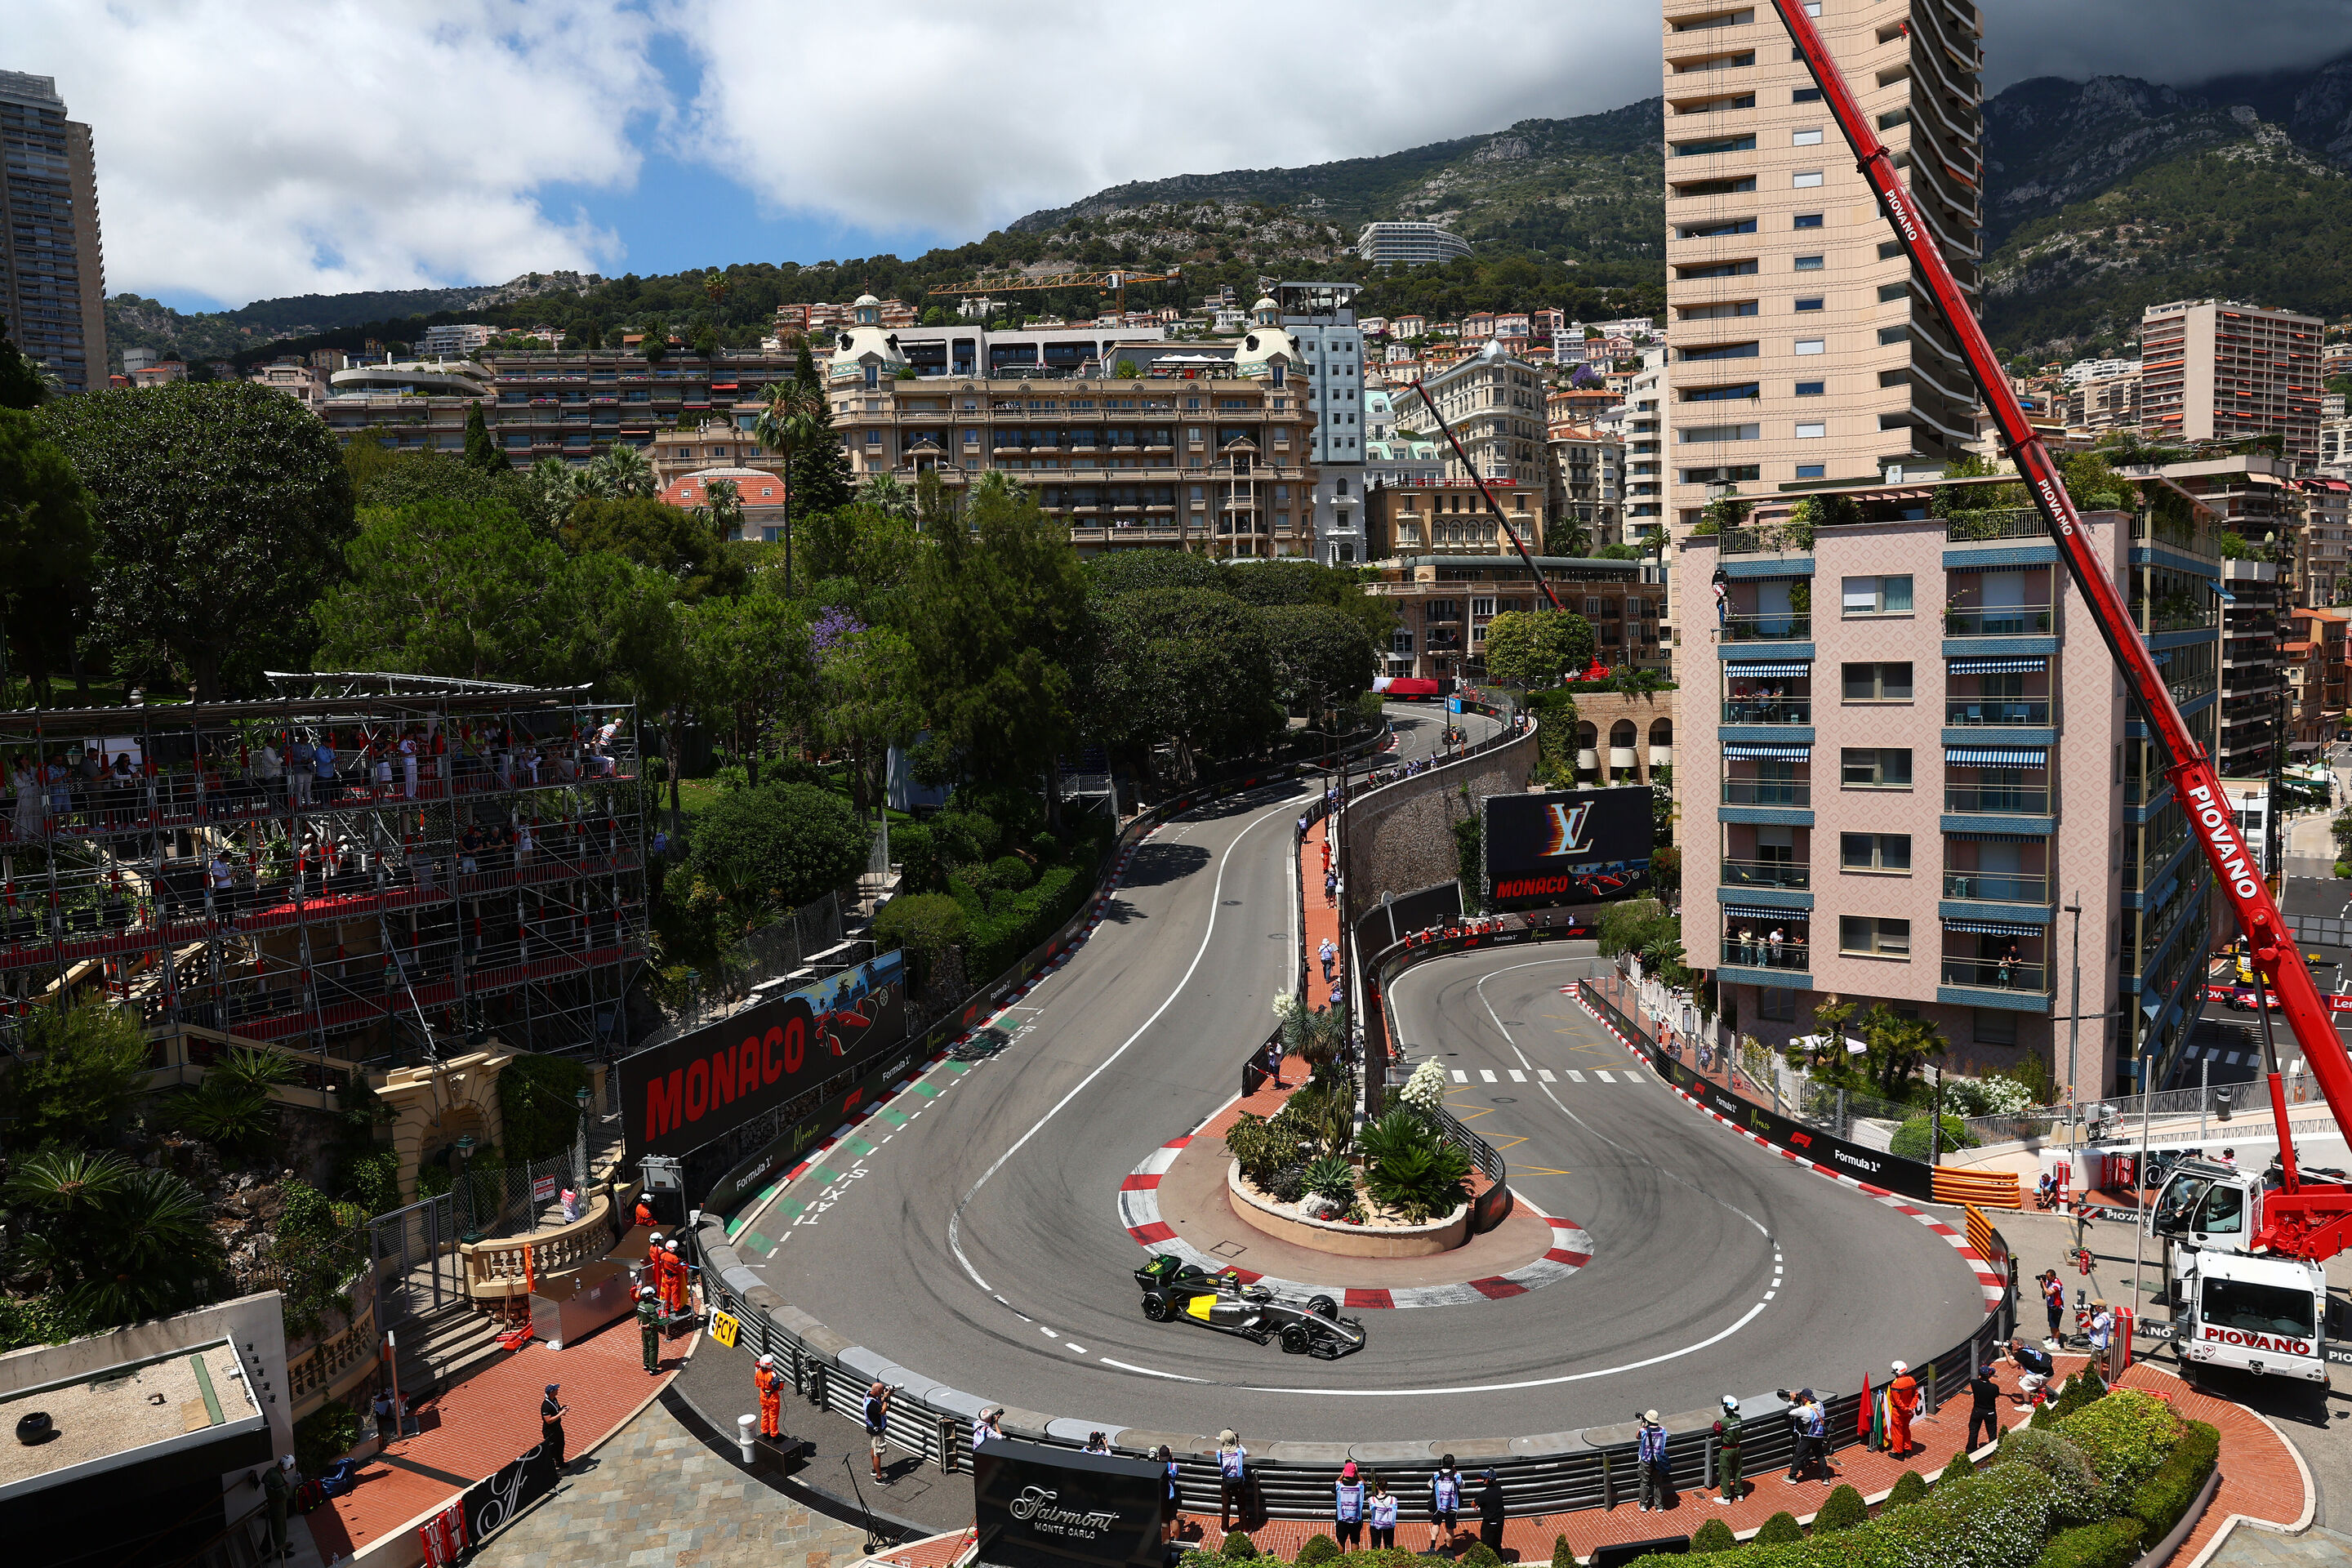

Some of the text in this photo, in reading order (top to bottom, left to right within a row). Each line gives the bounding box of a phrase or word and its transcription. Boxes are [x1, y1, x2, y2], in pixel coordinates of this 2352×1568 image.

[1885, 189, 1918, 241] PIOVANO
[2038, 479, 2074, 537] PIOVANO
[2188, 784, 2257, 899] PIOVANO
[1496, 875, 1568, 898] MONACO
[990, 983, 1007, 1001] Formula
[645, 1017, 804, 1143] MONACO
[882, 1060, 906, 1082] Formula
[1716, 1095, 1732, 1112] Formula
[794, 1124, 821, 1152] Monaco
[1834, 1149, 1870, 1170] Formula
[736, 1162, 766, 1192] Formula
[802, 1169, 869, 1225] TAXIS
[1210, 1308, 1233, 1316] Revolut
[715, 1316, 735, 1342] FCY
[2205, 1327, 2310, 1355] PIOVANO
[1009, 1486, 1120, 1532] Fairmont
[1034, 1521, 1096, 1539] MONTE CARLO
